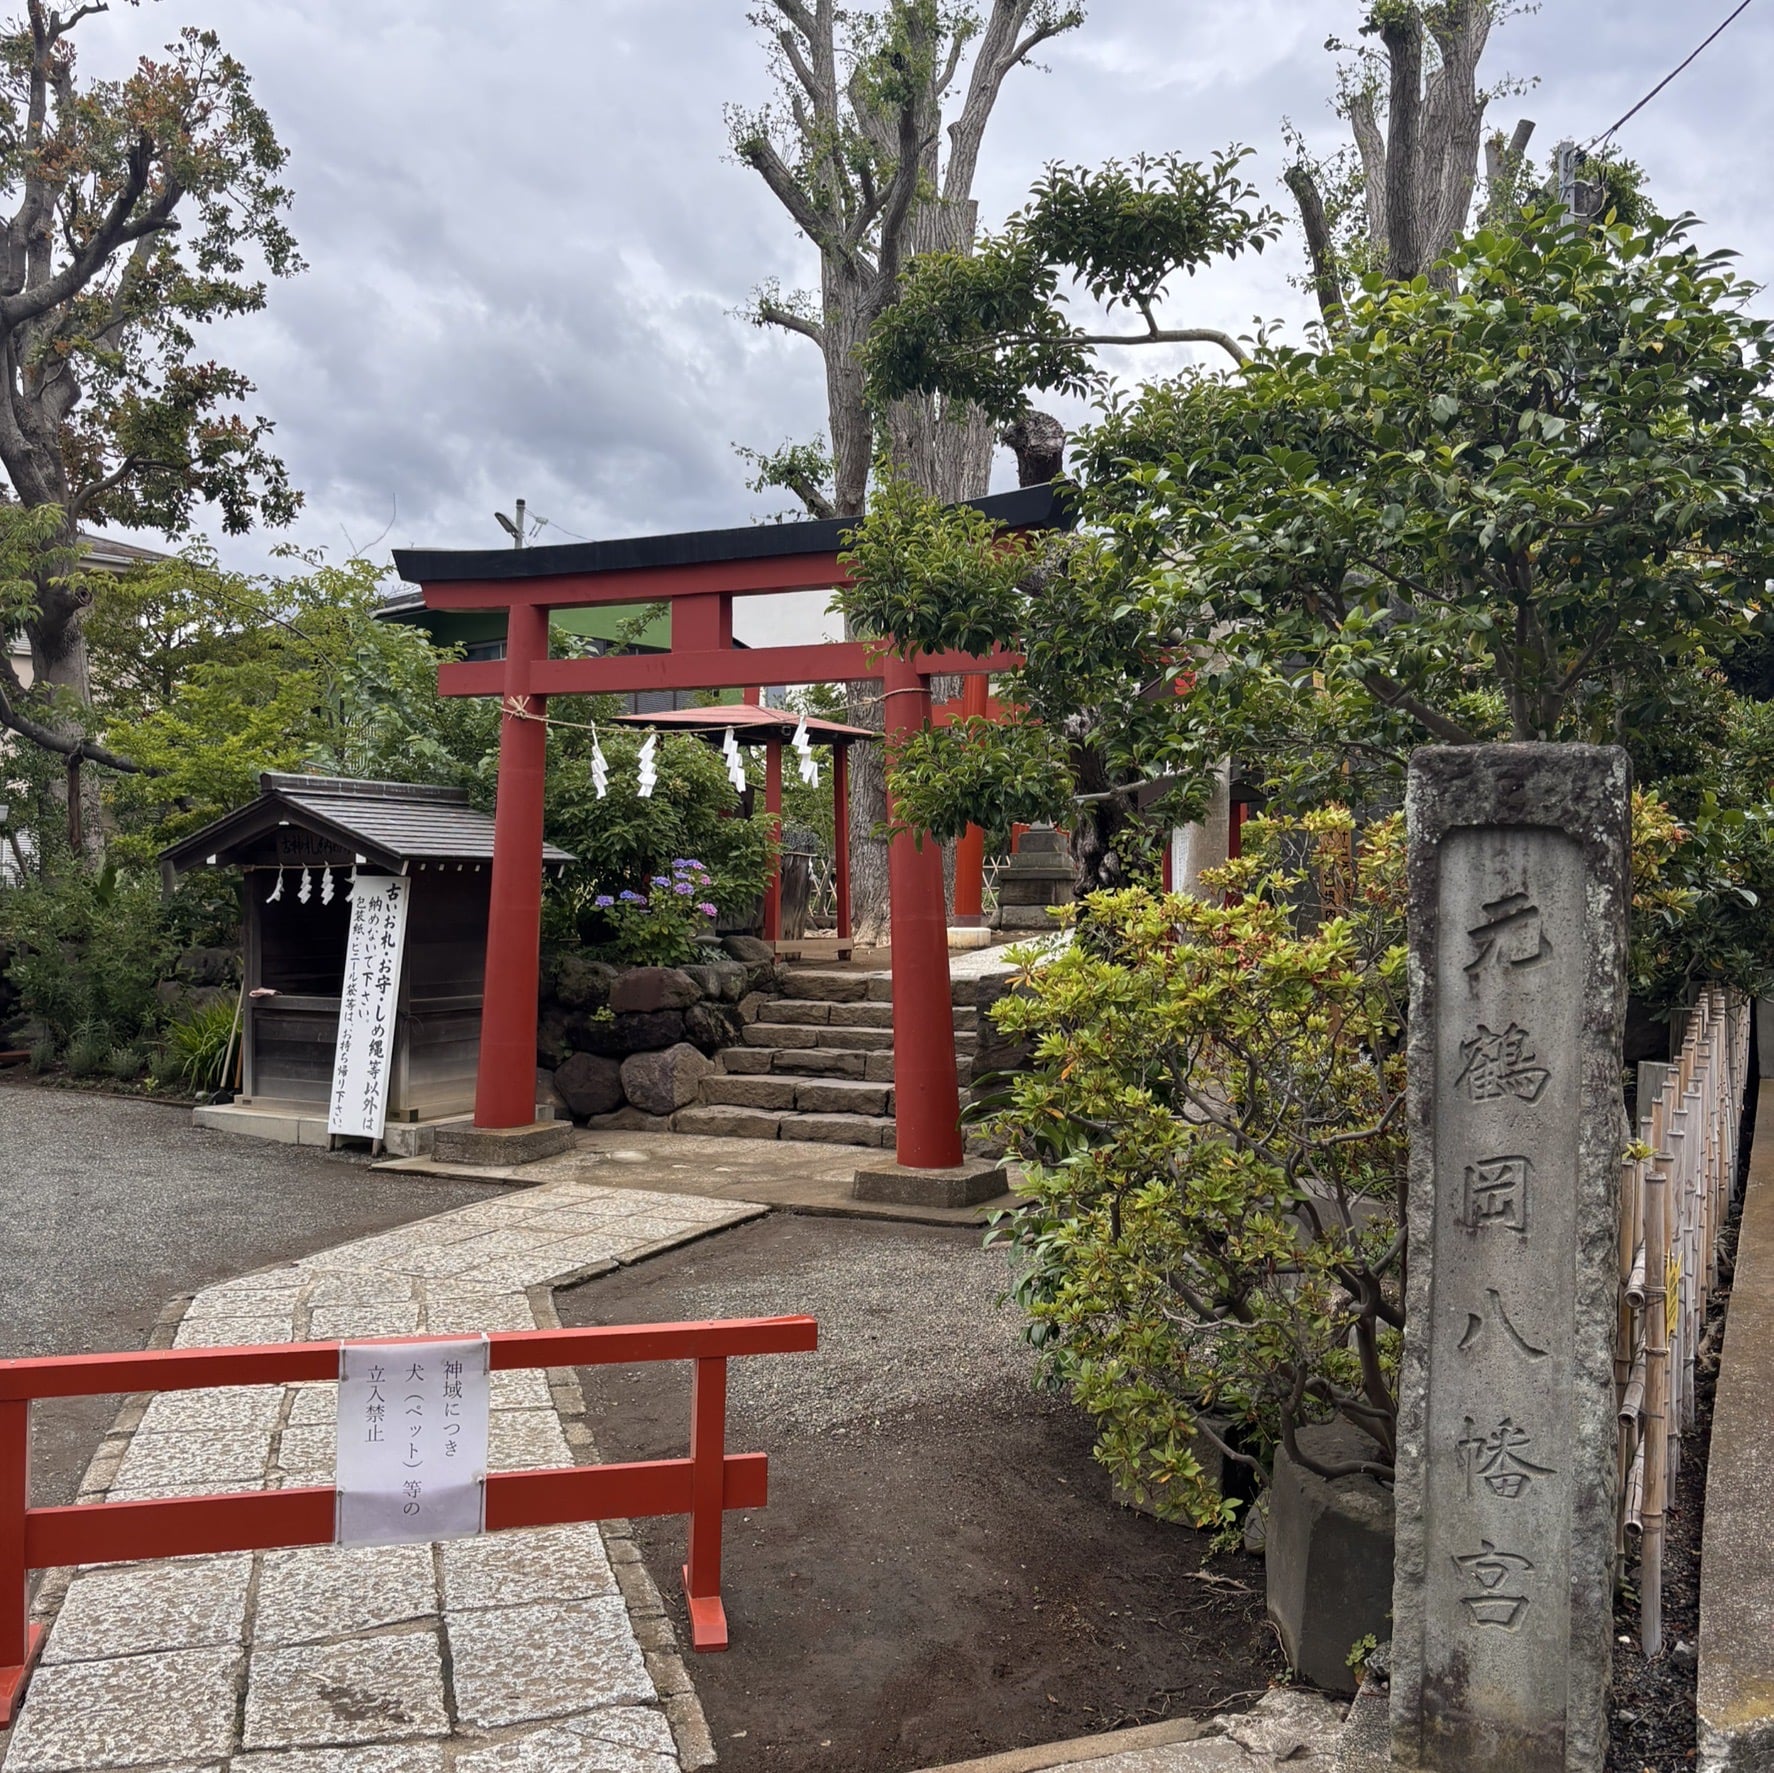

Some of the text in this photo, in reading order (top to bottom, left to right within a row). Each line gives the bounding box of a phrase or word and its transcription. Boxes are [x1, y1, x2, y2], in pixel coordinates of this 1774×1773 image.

[358, 897, 382, 1023] 納めないで下さい。
[362, 882, 402, 1130] 古いお札・お守・しめ縄等以外は
[1453, 891, 1558, 1633] 元鶴岡八幡宮
[364, 1364, 386, 1443] 立入禁止
[442, 1360, 463, 1457] 神域につき
